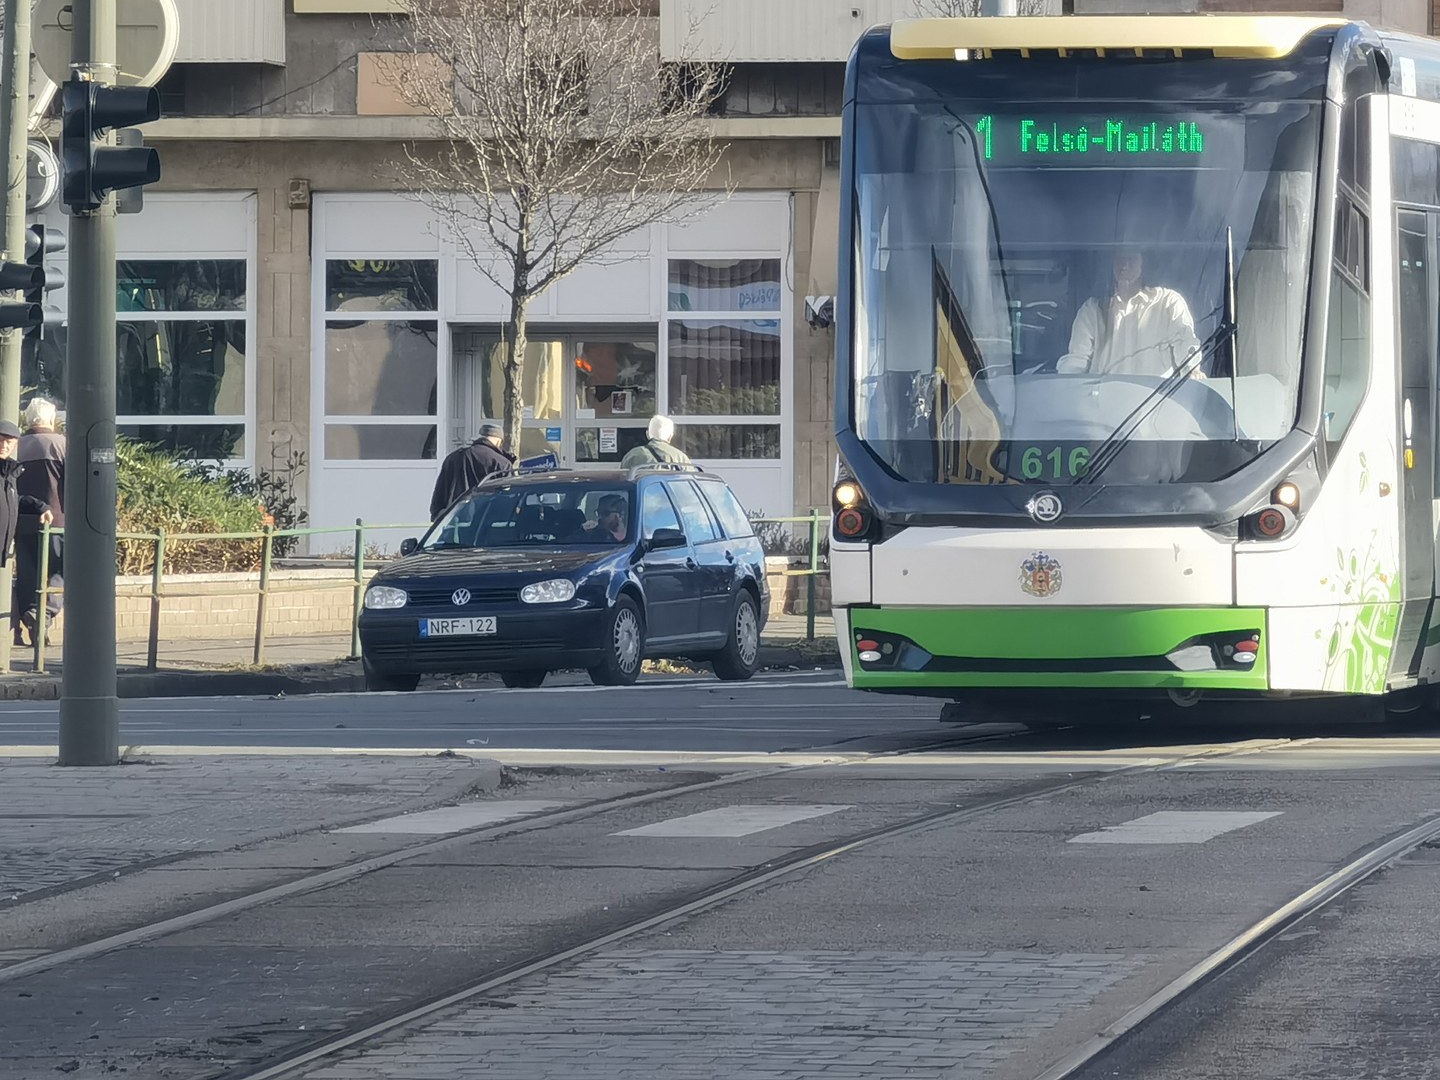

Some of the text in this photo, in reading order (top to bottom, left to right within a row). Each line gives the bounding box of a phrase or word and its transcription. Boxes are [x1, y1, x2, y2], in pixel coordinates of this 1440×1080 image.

[976, 115, 992, 160] 1
[1021, 446, 1091, 479] 616
[430, 619, 494, 634] NRF-122
